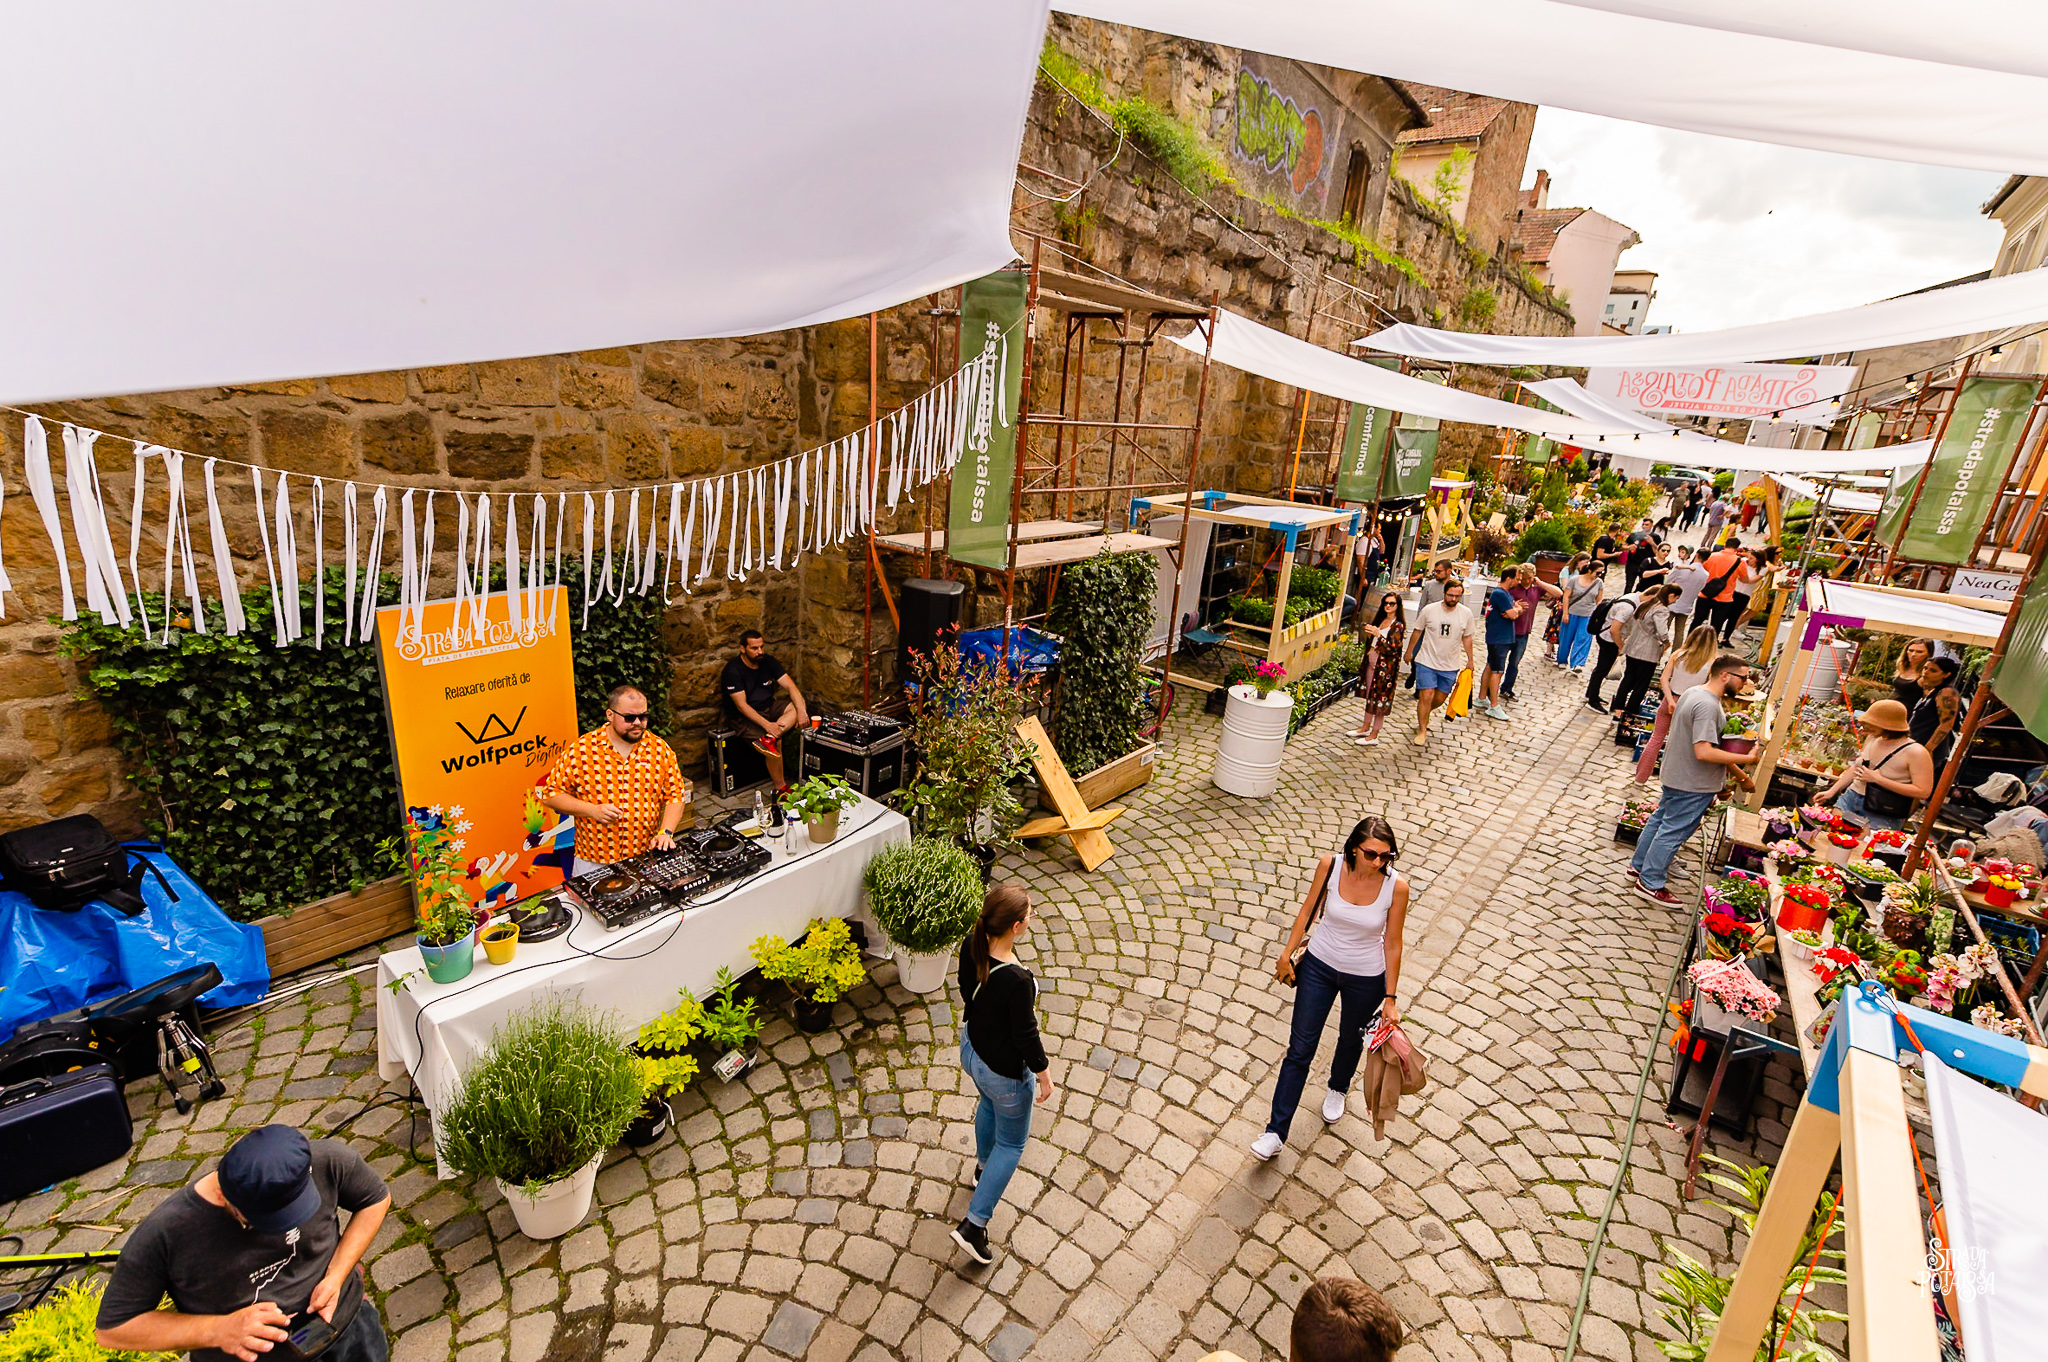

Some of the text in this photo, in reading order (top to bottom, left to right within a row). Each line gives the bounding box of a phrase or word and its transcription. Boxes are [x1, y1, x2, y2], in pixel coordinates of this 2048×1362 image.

[1936, 407, 2001, 535] #stradapotaissa
[452, 652, 463, 660] DE
[465, 648, 488, 657] FLORI
[444, 672, 531, 700] Relaxare oferită de
[440, 734, 548, 774] Wolfpack
[525, 739, 567, 768] Digital
